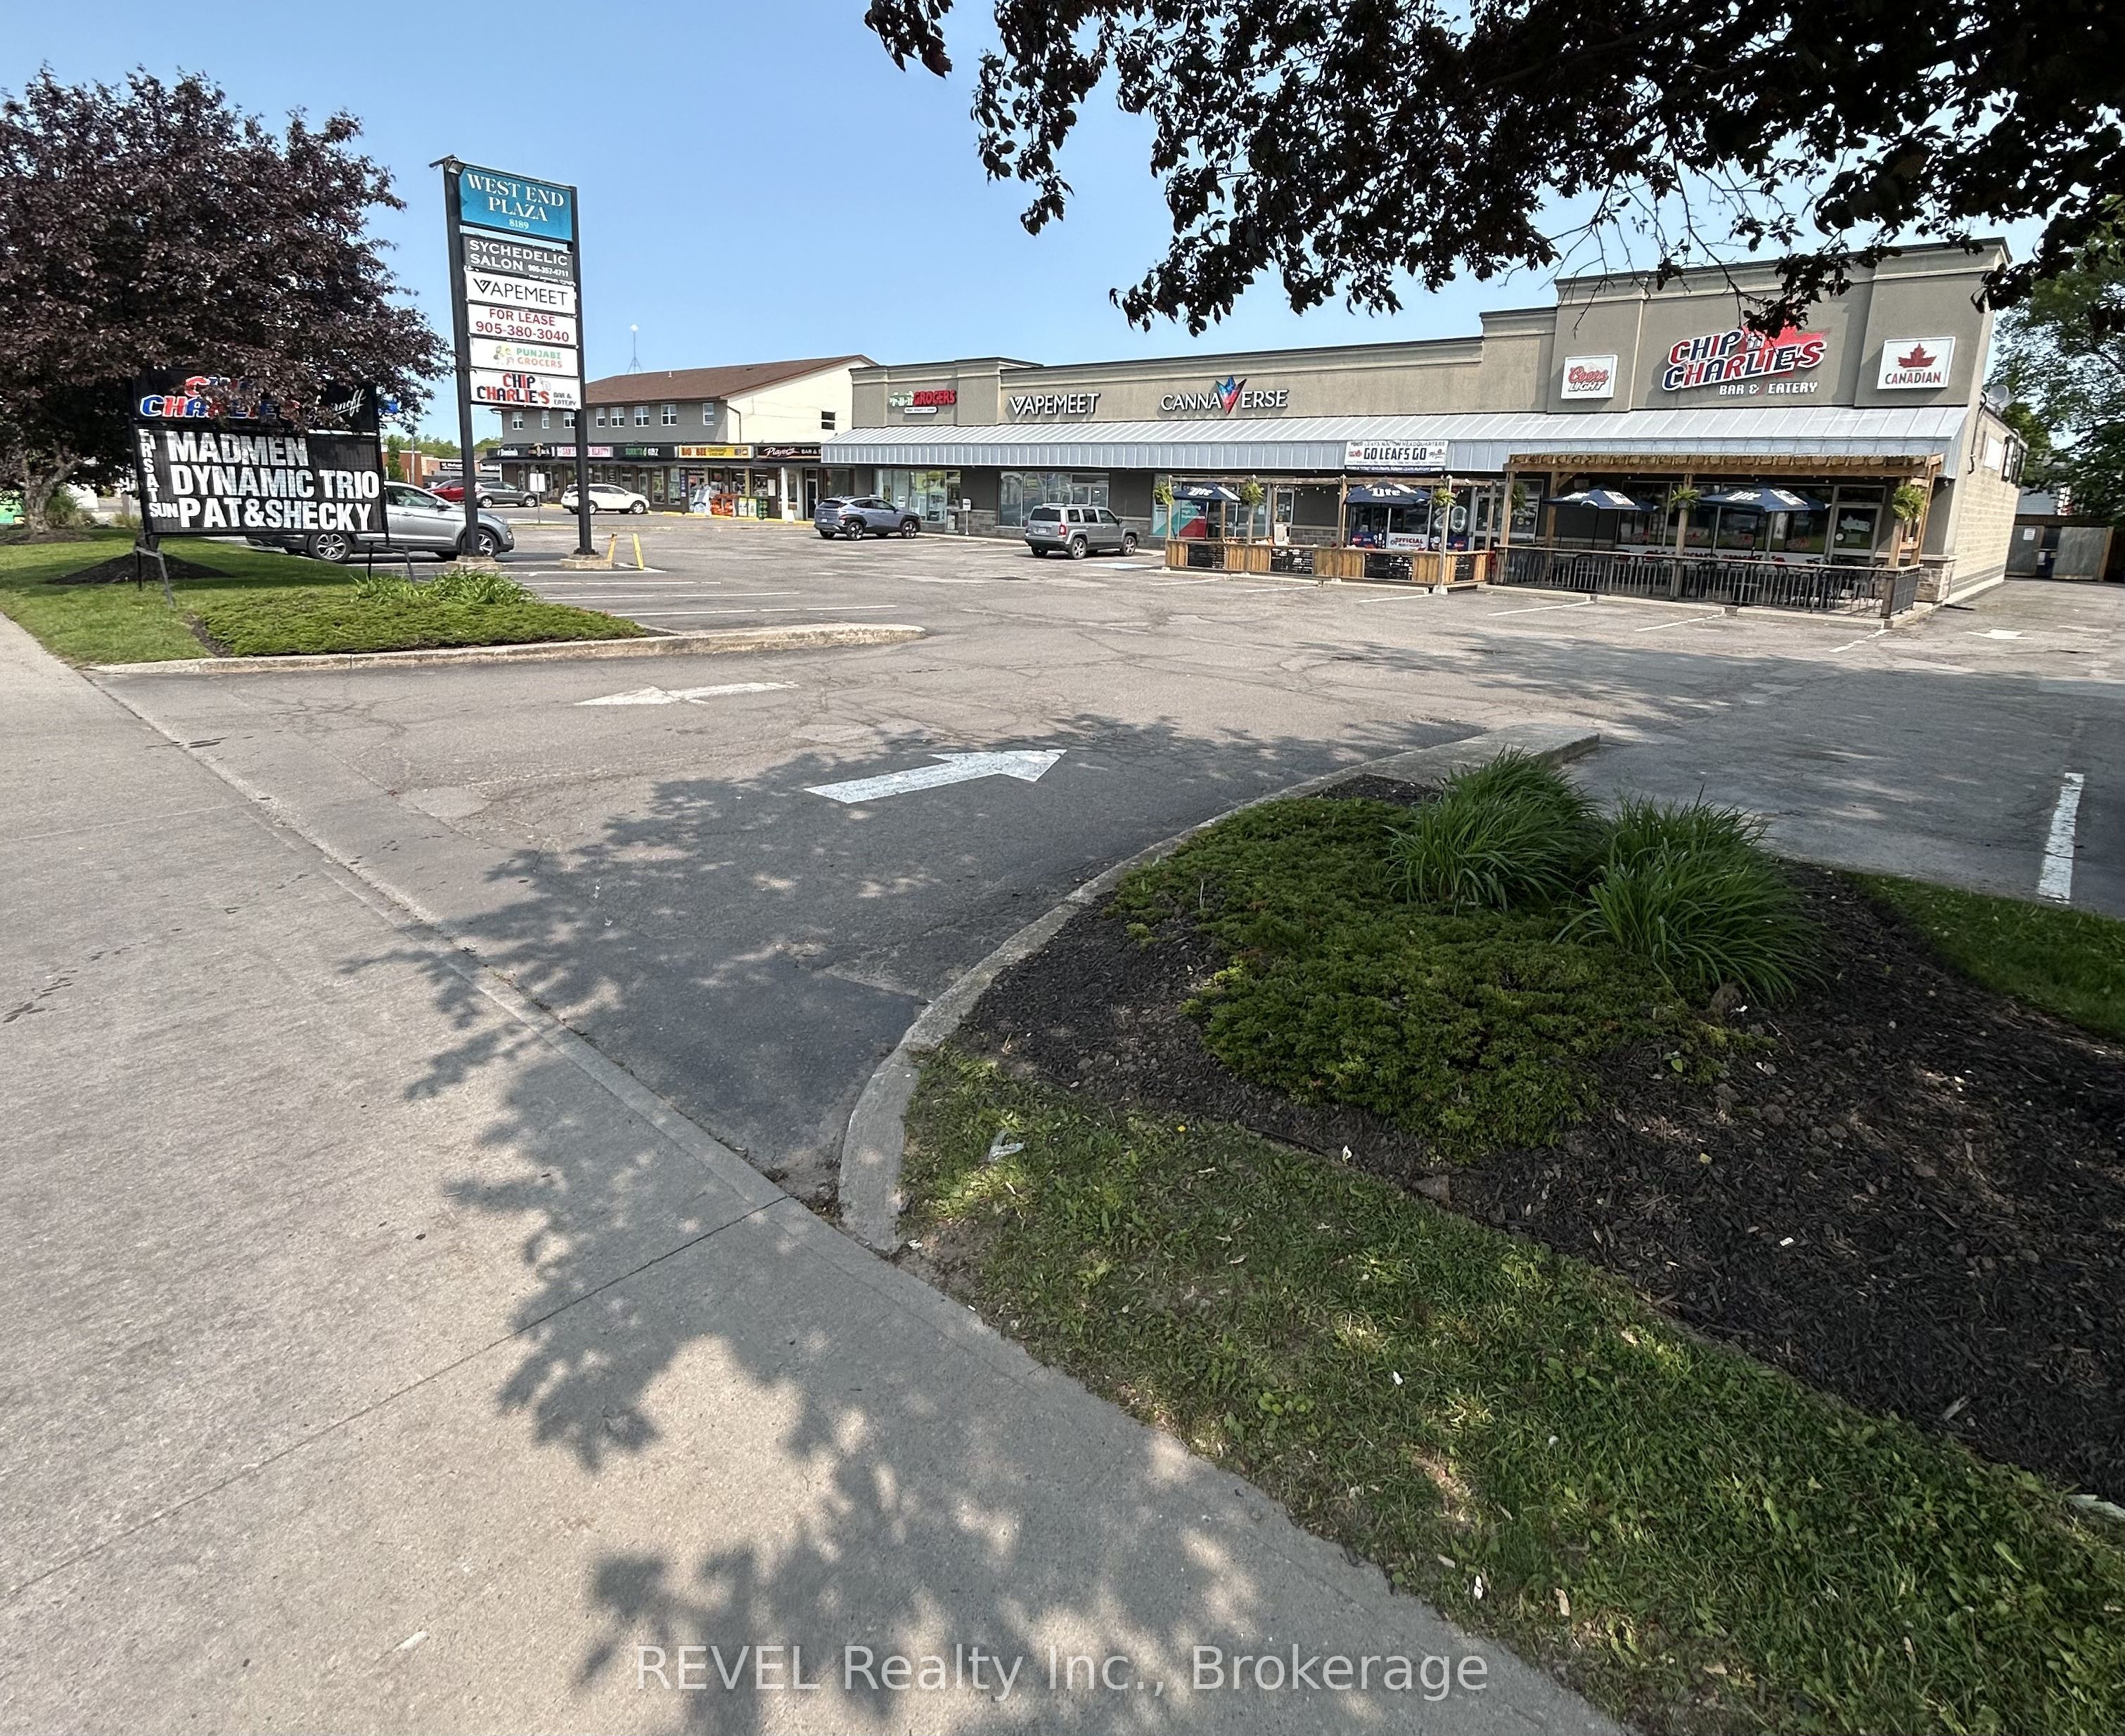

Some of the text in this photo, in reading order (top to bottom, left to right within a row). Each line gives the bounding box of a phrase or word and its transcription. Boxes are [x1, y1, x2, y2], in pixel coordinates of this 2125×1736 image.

[467, 174, 564, 207] WEST END
[489, 197, 548, 222] PLAZA
[508, 219, 529, 229] 8189
[470, 239, 568, 266] SYCHEDELIC
[470, 253, 523, 271] SALON
[473, 278, 568, 305] VAPEMEET
[489, 308, 556, 326] FOR LEASE
[475, 321, 569, 342] 905-380-3040
[516, 347, 561, 359] PUNJABI
[1669, 329, 1745, 366] CHIP
[517, 357, 563, 368] GROCERS
[1662, 339, 1827, 391] CHARLIE'S
[502, 373, 536, 389] CHIP
[1568, 366, 1609, 384] Coors
[1885, 371, 1941, 385] CANADIAN
[477, 385, 550, 404] CHARLIE'S
[1568, 381, 1606, 392] LIGHT
[1719, 382, 1818, 395] BAR & EATERY
[913, 390, 956, 406] GROCERS
[1009, 394, 1100, 415] VAPEMEET
[166, 430, 308, 466] MADMEN
[1363, 447, 1378, 460] GO
[1380, 447, 1410, 461] LEAFS
[1412, 447, 1427, 461] GO
[170, 464, 379, 499] DYNAMIC TRIO
[148, 503, 179, 518] SUN
